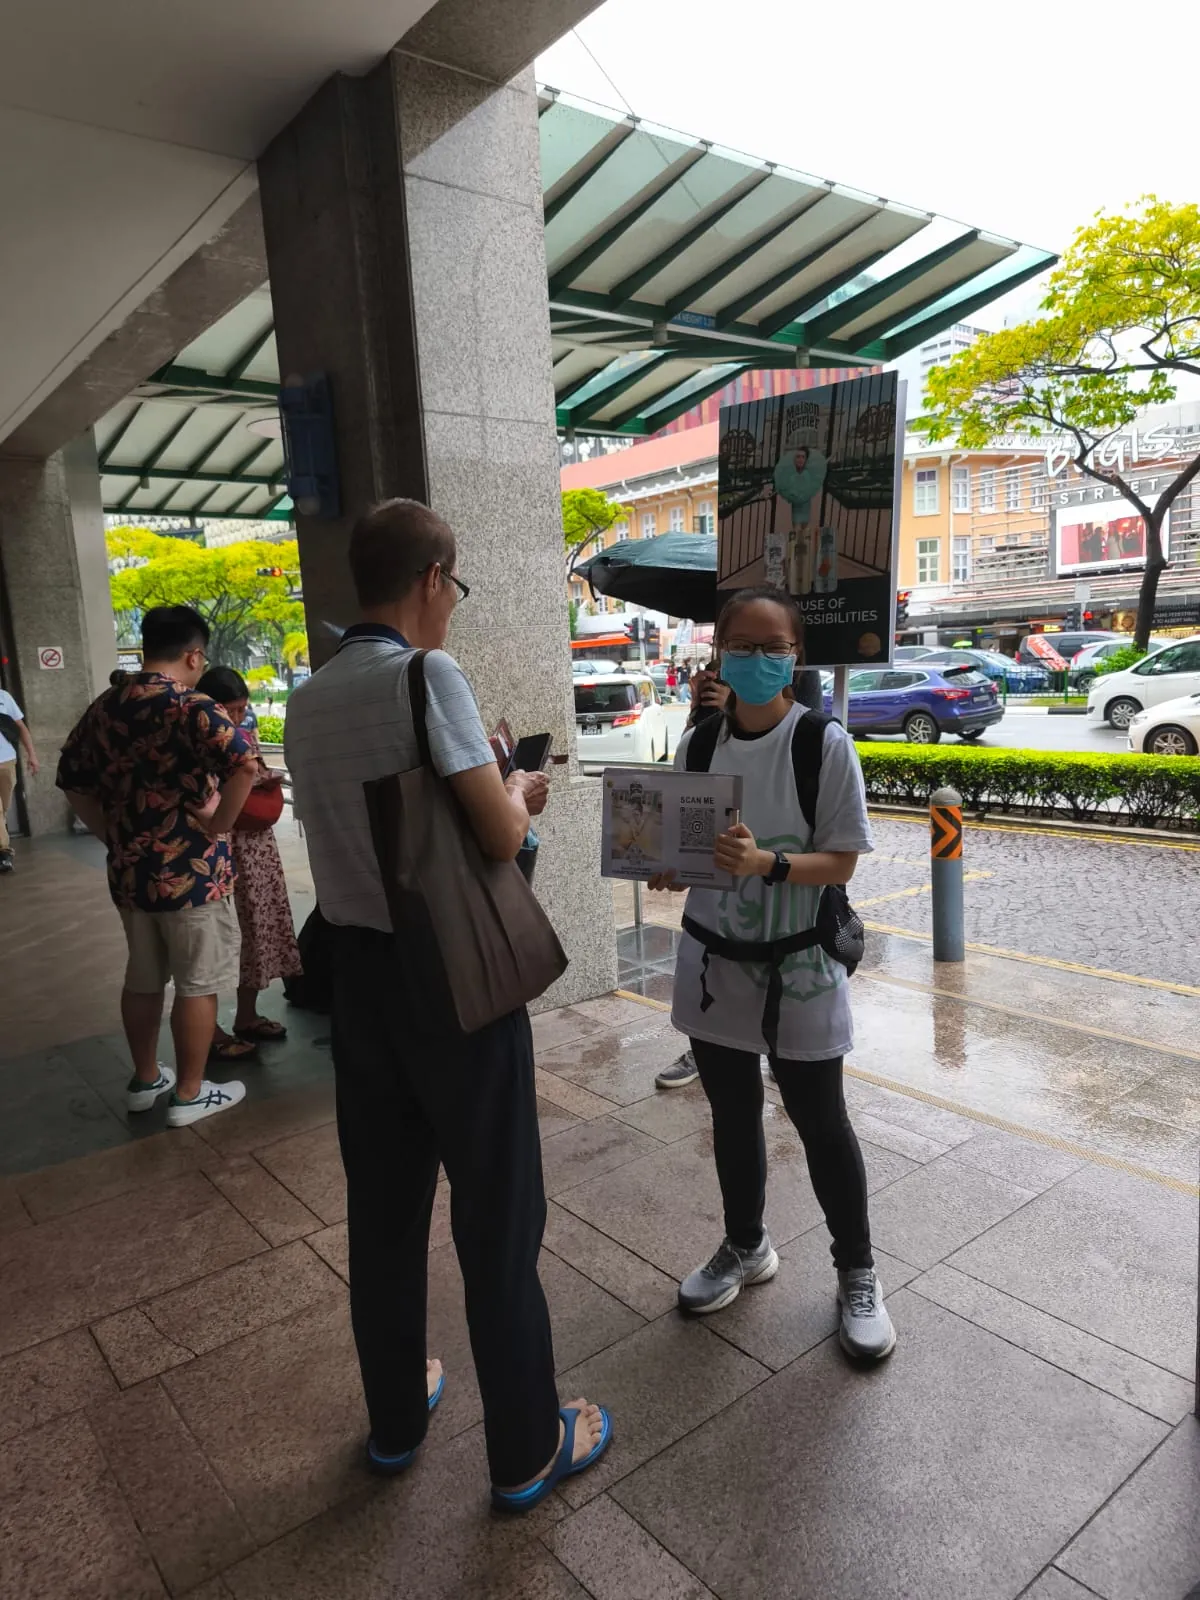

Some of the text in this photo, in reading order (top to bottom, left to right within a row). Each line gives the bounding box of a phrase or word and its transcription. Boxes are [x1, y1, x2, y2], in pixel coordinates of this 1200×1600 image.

[1059, 478, 1159, 505] STREET
[796, 597, 846, 611] USE OF
[800, 610, 878, 624] OSSIBILITIES
[680, 796, 714, 804] SCAN ME
